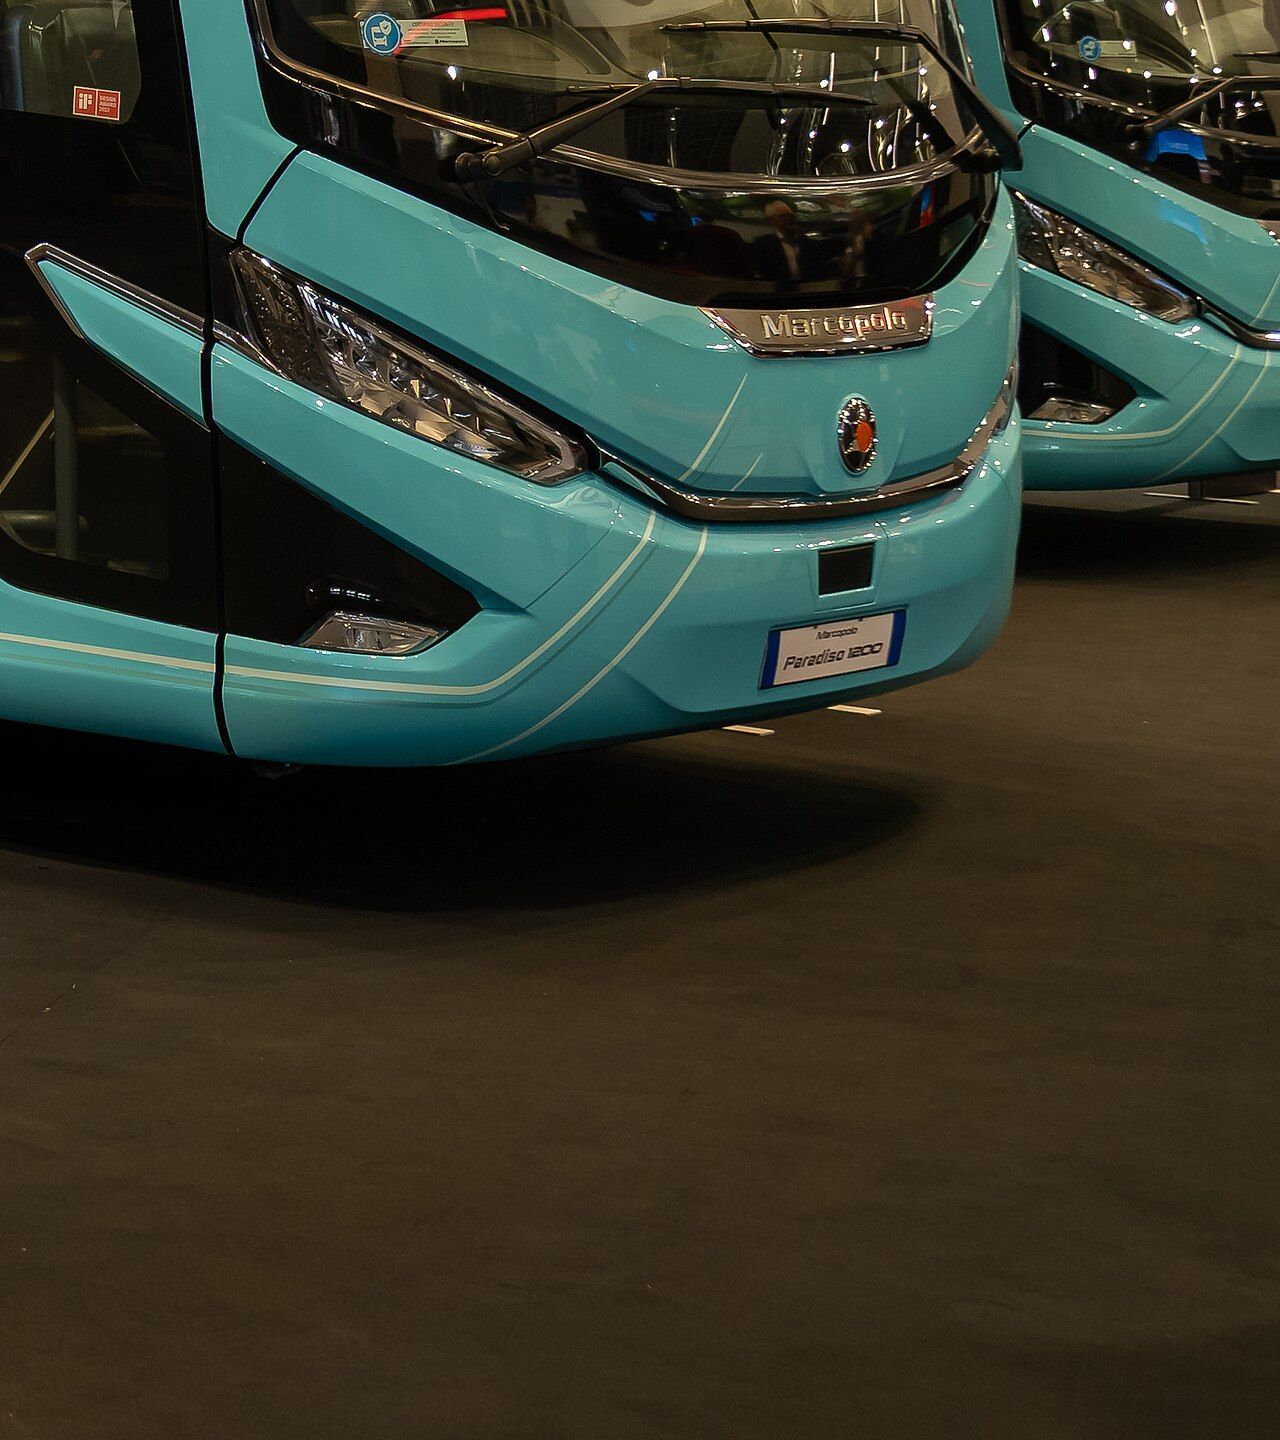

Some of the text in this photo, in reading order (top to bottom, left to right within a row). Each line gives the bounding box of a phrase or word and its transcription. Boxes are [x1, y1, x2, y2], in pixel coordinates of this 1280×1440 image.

[761, 307, 908, 339] Marcopolo
[816, 627, 858, 640] Marcopolo
[783, 642, 883, 670] Paradiso 1200
